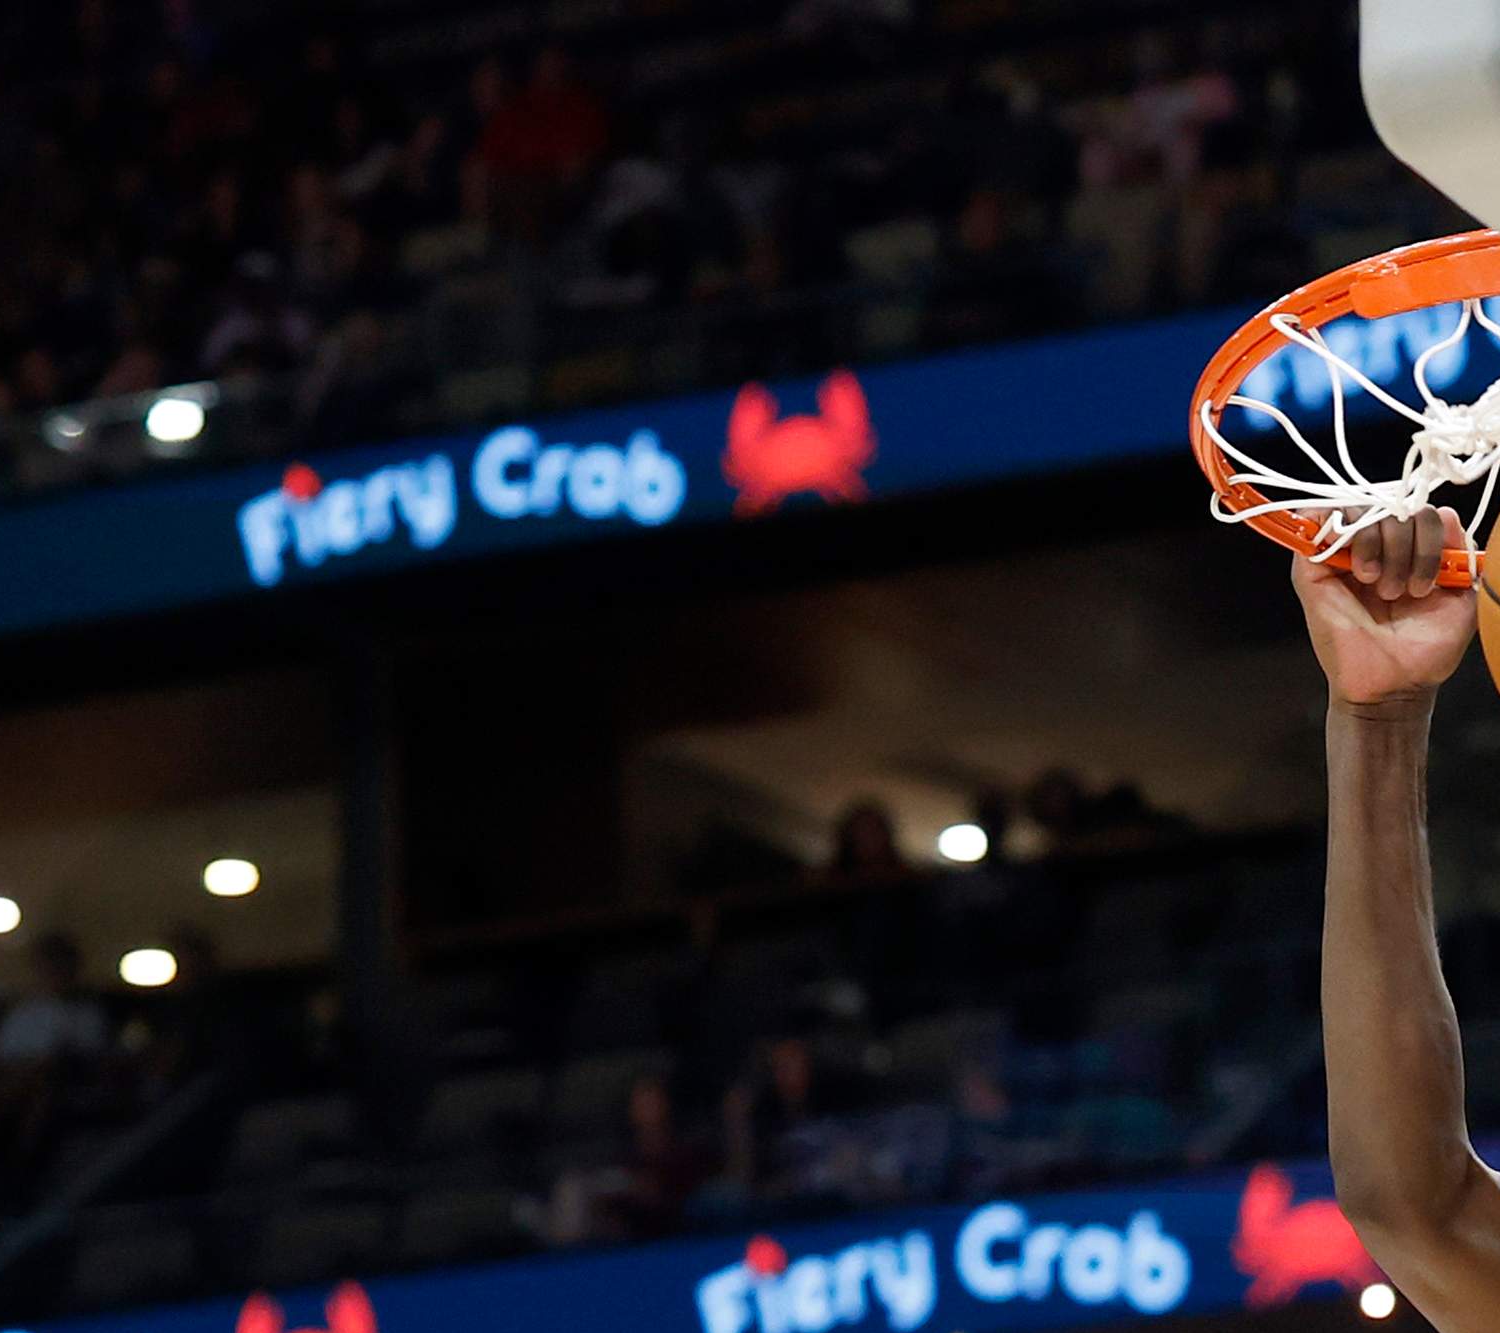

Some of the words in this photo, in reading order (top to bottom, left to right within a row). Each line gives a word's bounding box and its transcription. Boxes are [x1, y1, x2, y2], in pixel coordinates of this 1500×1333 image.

[240, 456, 455, 583] Fiery
[473, 427, 684, 525] Crab
[956, 1203, 1189, 1313] Crab
